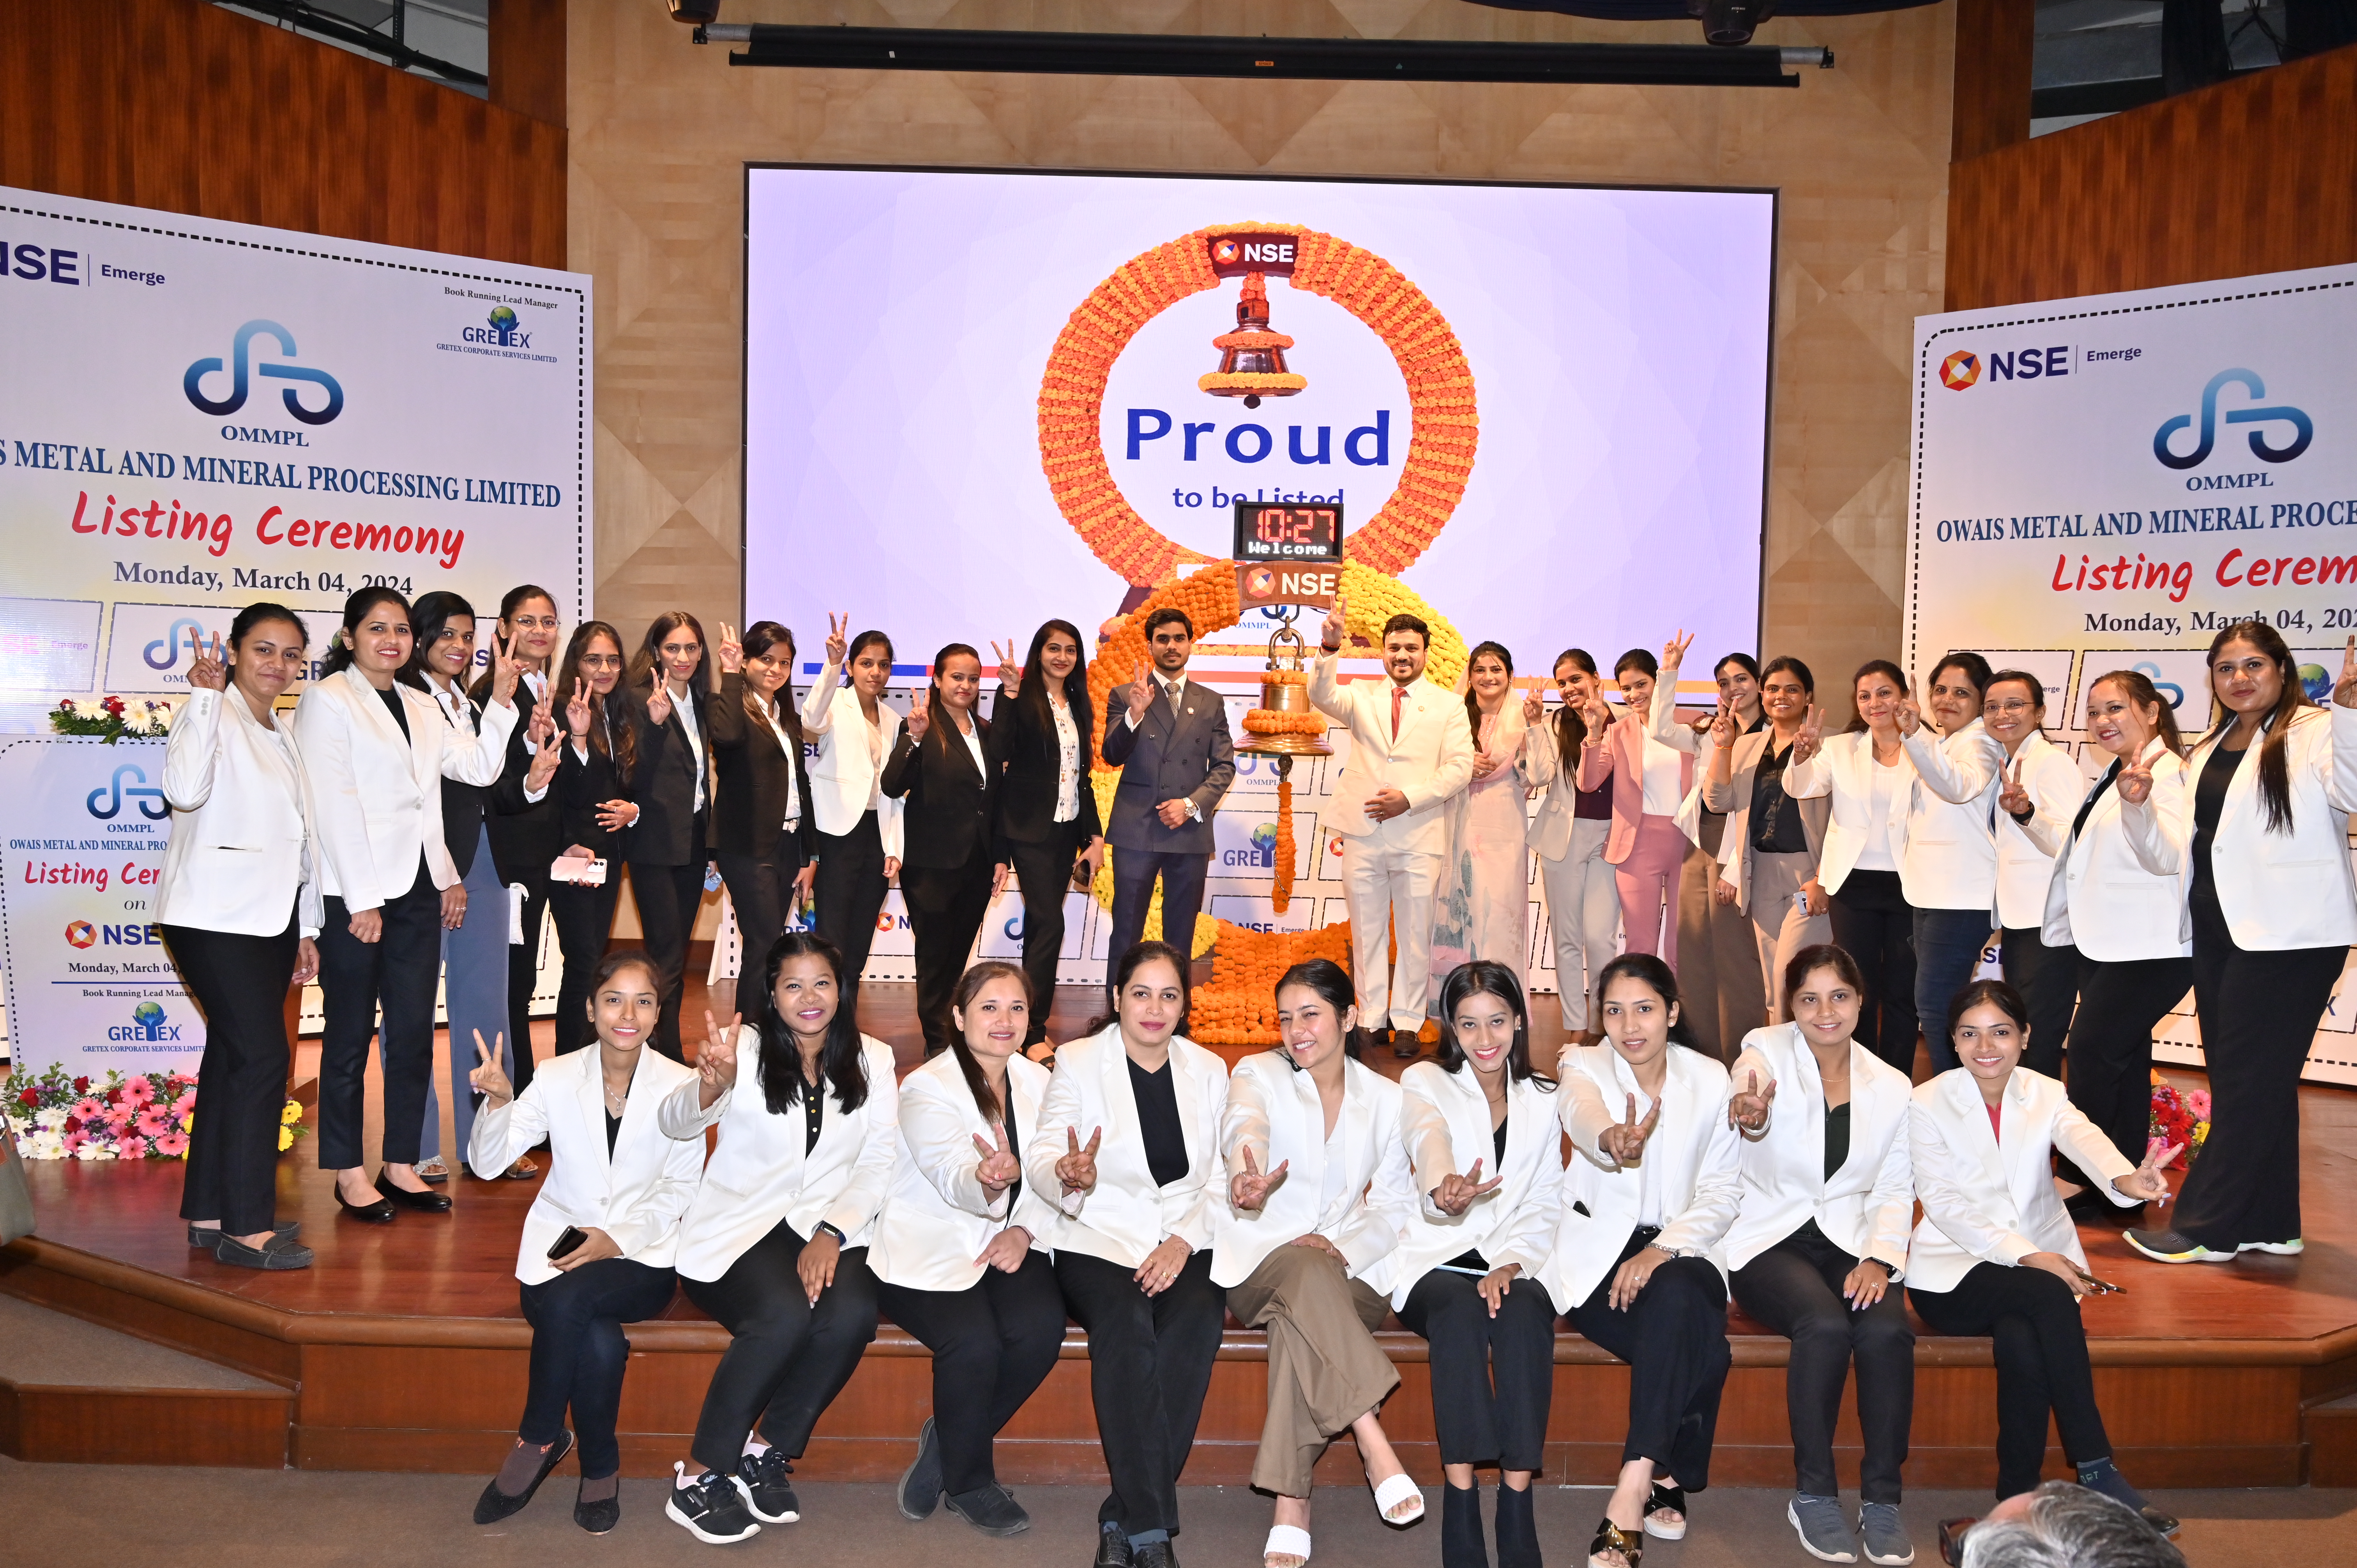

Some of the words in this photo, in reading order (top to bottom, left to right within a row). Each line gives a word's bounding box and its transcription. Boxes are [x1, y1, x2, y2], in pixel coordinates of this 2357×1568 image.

[1245, 244, 1293, 262] NSE
[102, 265, 165, 286] Emerge
[444, 287, 465, 297] Book
[467, 290, 501, 303] Running
[504, 295, 522, 304] Lead
[524, 298, 558, 309] Manager
[436, 343, 462, 352] GRETEX
[463, 346, 501, 357] CORPORATE
[502, 351, 530, 360] SERVICES
[532, 354, 557, 363] LIMITED
[1989, 346, 2068, 381] NSE
[2087, 347, 2141, 362] Emerge
[221, 426, 309, 447] OMMPL
[1126, 408, 1390, 466] Proud
[15, 441, 113, 474] METAL
[118, 450, 175, 478] AND
[183, 456, 302, 489] MINERAL
[307, 466, 459, 500] PROCESSING
[465, 479, 561, 507] LIMITED
[2186, 472, 2274, 491] OMMPL
[1173, 488, 1202, 507] to
[1213, 486, 1247, 508] be
[72, 491, 232, 556] Listing
[257, 506, 464, 569] Ceremony
[1257, 509, 1335, 543] 10:27
[1936, 517, 2004, 542] OWAIS
[2009, 514, 2088, 539] METAL
[2092, 512, 2142, 536] AND
[2149, 506, 2264, 534] MINERAL
[1248, 542, 1327, 555] Welcome
[113, 562, 223, 592] Monday,
[232, 568, 311, 591] March
[318, 572, 352, 597] 04,
[362, 574, 413, 595] 2024
[1282, 573, 1336, 595] NSE
[2051, 553, 2193, 602] Listing
[2084, 612, 2181, 635] Monday,
[2277, 609, 2313, 634] 04,
[52, 641, 88, 650] Emerge
[107, 824, 154, 832] OMMPL
[10, 839, 41, 849] OWAIS
[43, 840, 77, 850] METAL
[79, 840, 99, 850] AND
[101, 840, 146, 850] MINERAL
[25, 861, 108, 892] Listing
[124, 900, 147, 910] on
[103, 925, 161, 945] NSE
[68, 963, 118, 974] Monday,
[122, 963, 160, 973] March
[163, 963, 180, 975] 04,
[106, 990, 141, 998] Running
